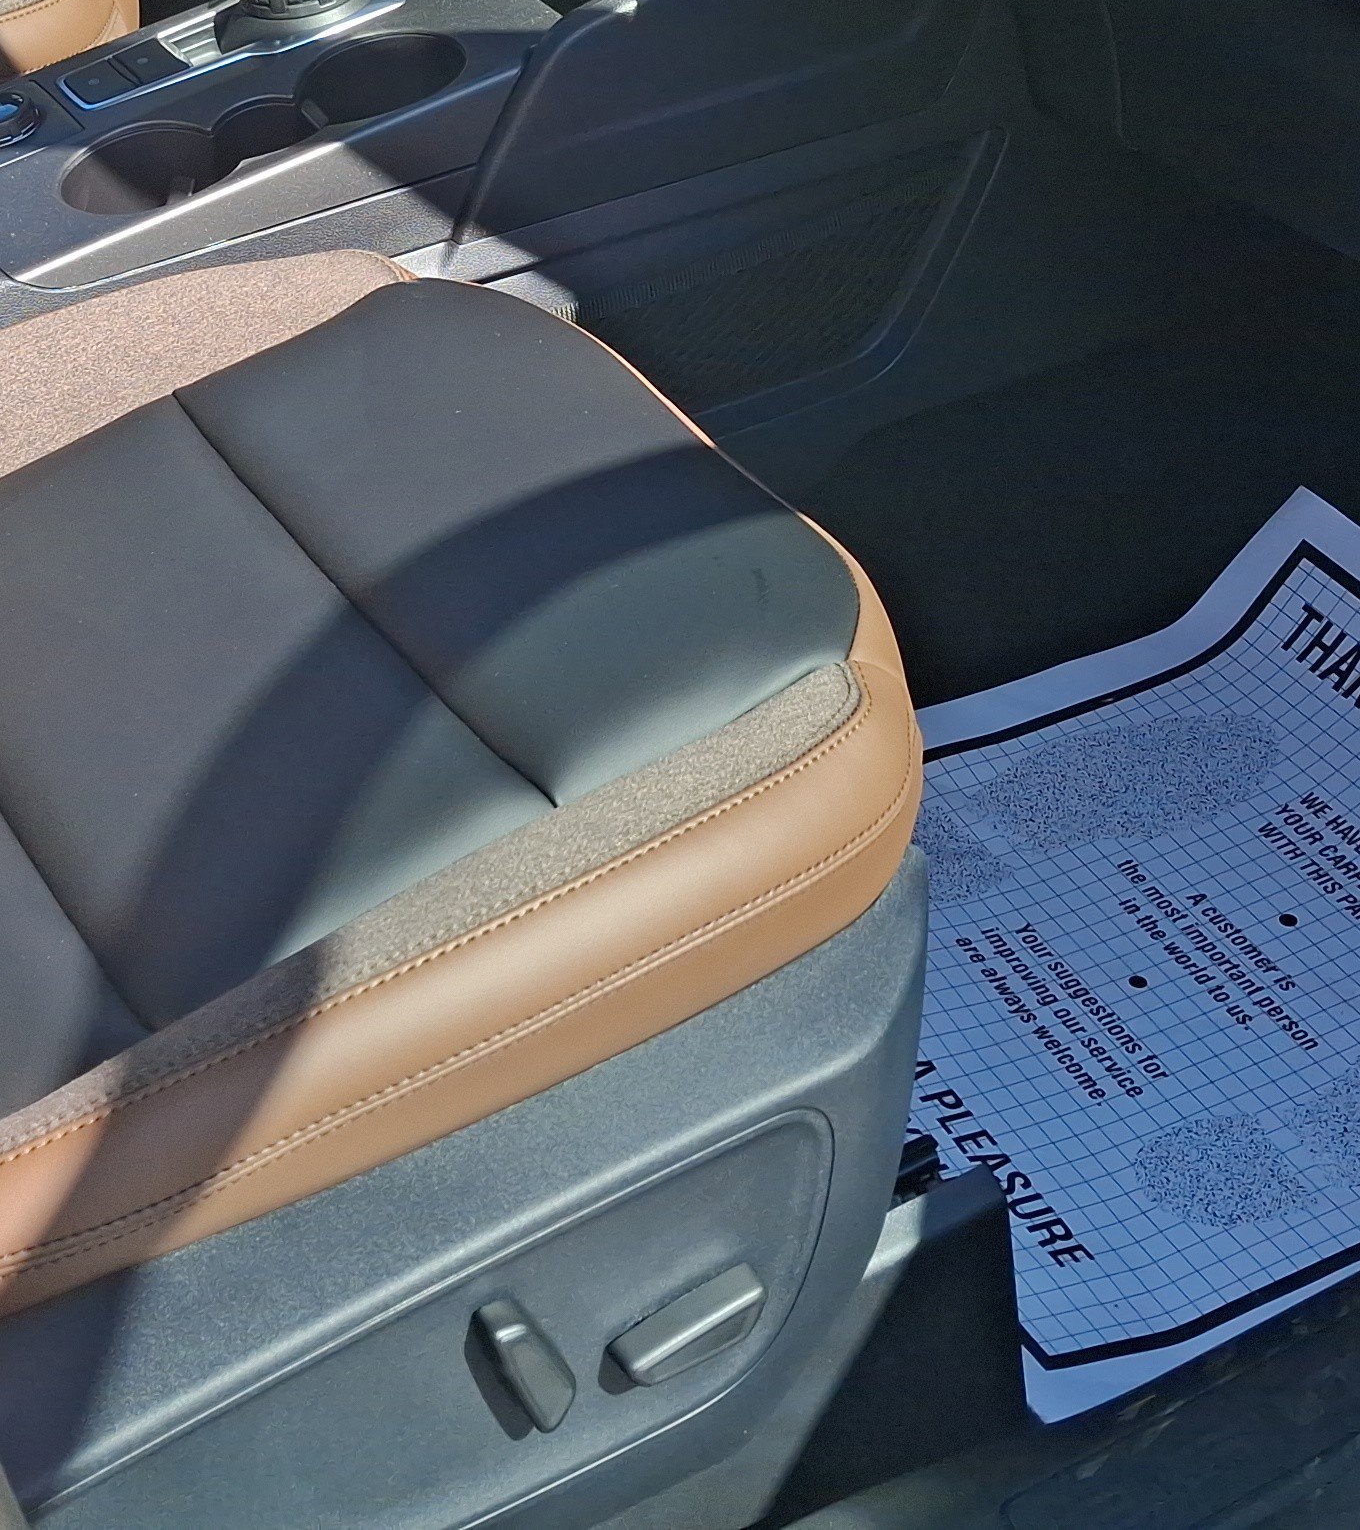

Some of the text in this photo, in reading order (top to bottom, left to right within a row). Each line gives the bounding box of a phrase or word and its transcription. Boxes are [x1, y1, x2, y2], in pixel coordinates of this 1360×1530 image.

[1257, 821, 1307, 861] WITH
[1300, 858, 1344, 896] THIS
[1274, 803, 1324, 846] YOUR
[1300, 791, 1333, 820] WE
[980, 926, 1145, 1099] improving our service
[1015, 922, 1170, 1080] Your suggestions for
[1116, 859, 1320, 1052] the most important person
[1119, 897, 1253, 1031] in the world to us.
[1185, 892, 1297, 992] A customer is
[955, 936, 1108, 1107] are always welcome.
[918, 1088, 1096, 1269] PLEASURE
